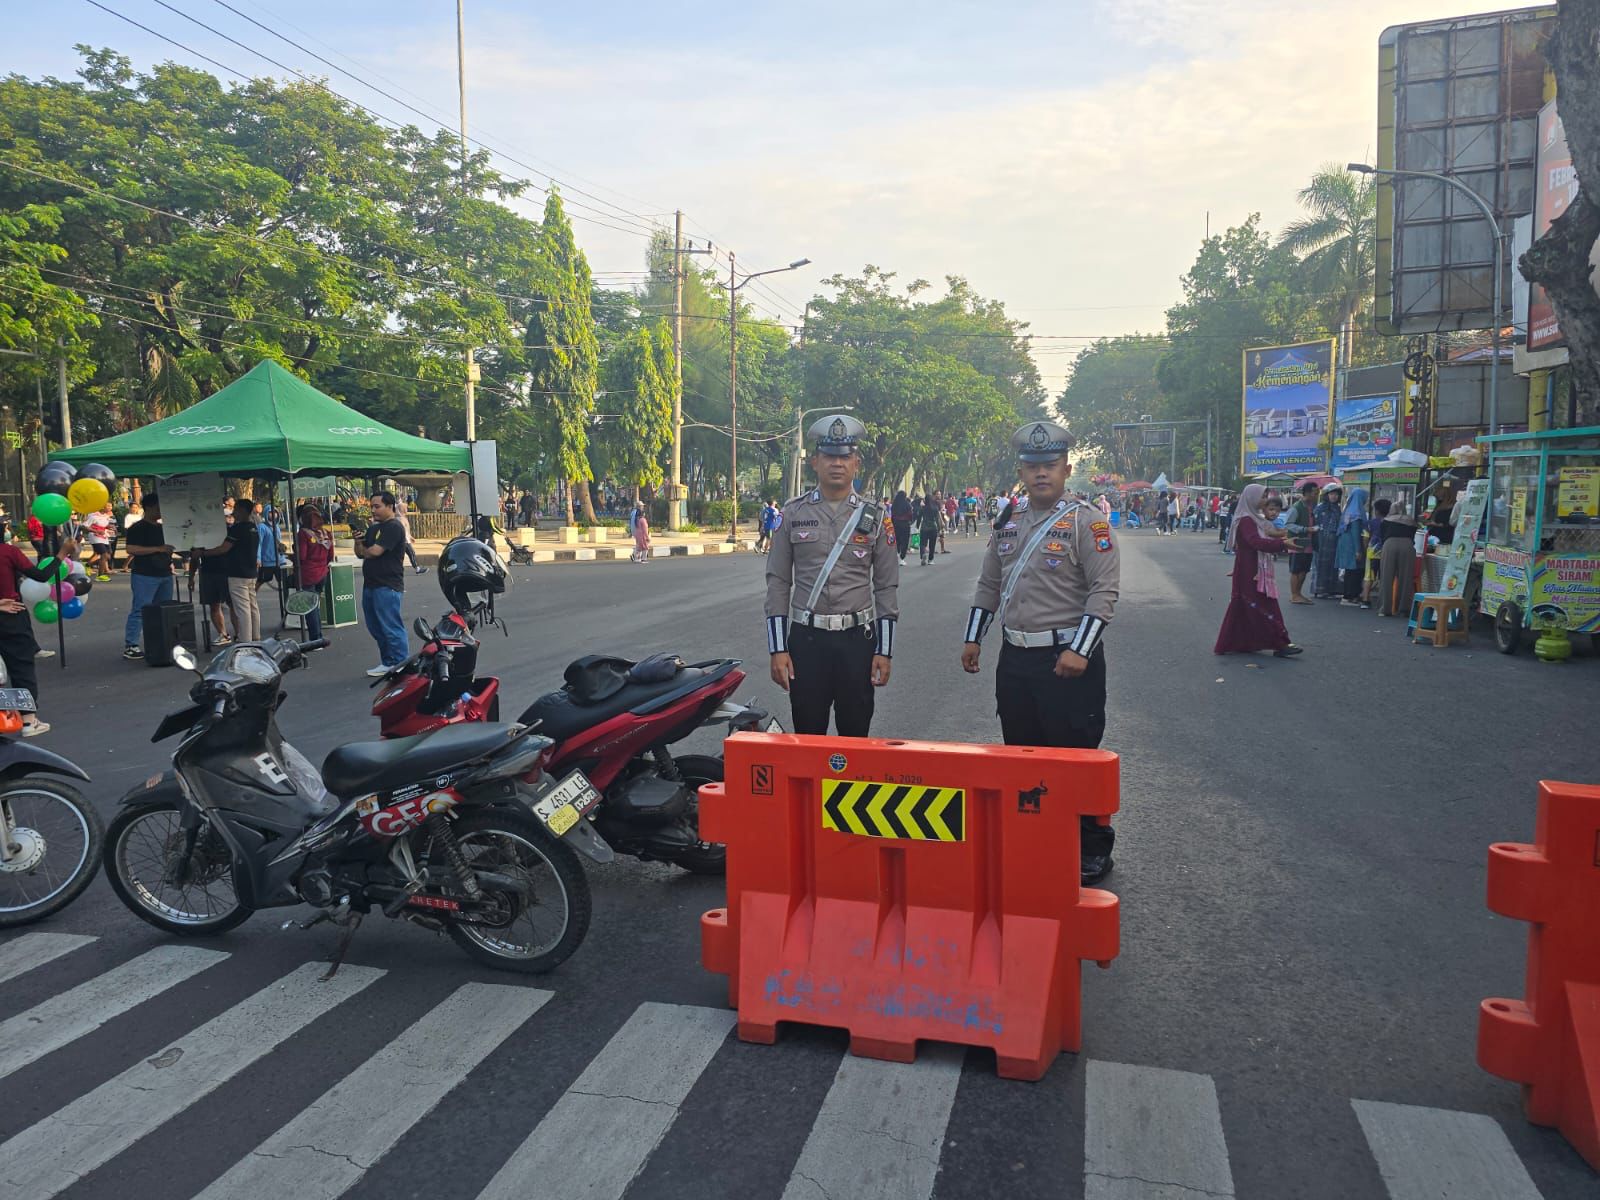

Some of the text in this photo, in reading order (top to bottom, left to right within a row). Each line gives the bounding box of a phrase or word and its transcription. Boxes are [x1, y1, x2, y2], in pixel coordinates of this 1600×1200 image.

[169, 425, 235, 436] oppo
[1251, 456, 1323, 465] ASTANA KENCANA
[1045, 530, 1072, 540] POLRI
[1557, 570, 1591, 581] SIRAM
[336, 594, 354, 602] oppo
[537, 808, 550, 819] S
[551, 788, 573, 809] 4631
[573, 776, 588, 791] LE
